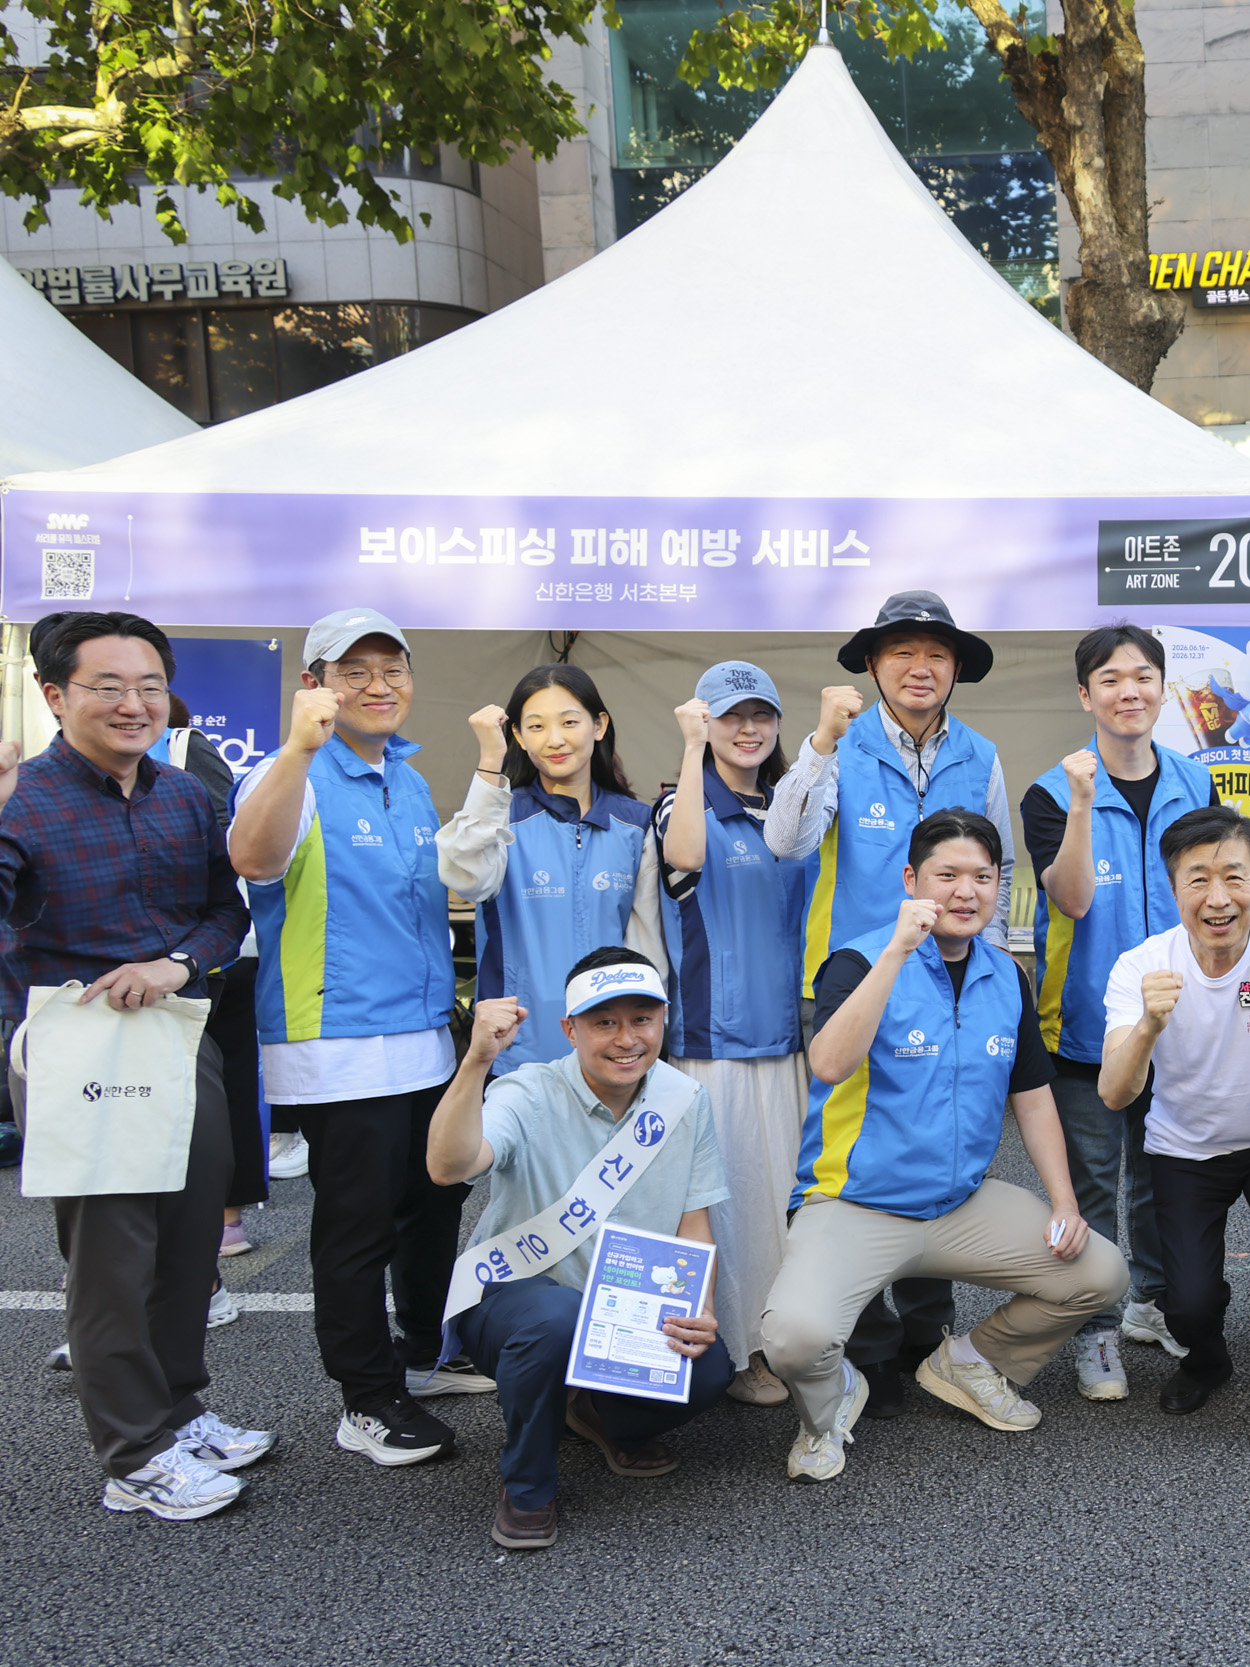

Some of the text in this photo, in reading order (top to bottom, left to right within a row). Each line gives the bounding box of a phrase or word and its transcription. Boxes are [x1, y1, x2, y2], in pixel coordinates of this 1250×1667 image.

[1206, 290, 1227, 304] 골든
[358, 527, 870, 568] 보이스피싱 피해 예방 서비스
[1124, 535, 1181, 562] 아트존
[1126, 573, 1180, 589] ART ZONE
[535, 582, 698, 603] 신한은행 서초본부
[729, 668, 752, 678] Type
[725, 675, 759, 686] Service
[205, 714, 227, 727] 순간
[1231, 749, 1242, 761] 첫
[590, 969, 645, 988] Dodgers
[103, 1085, 152, 1098] 신한은행
